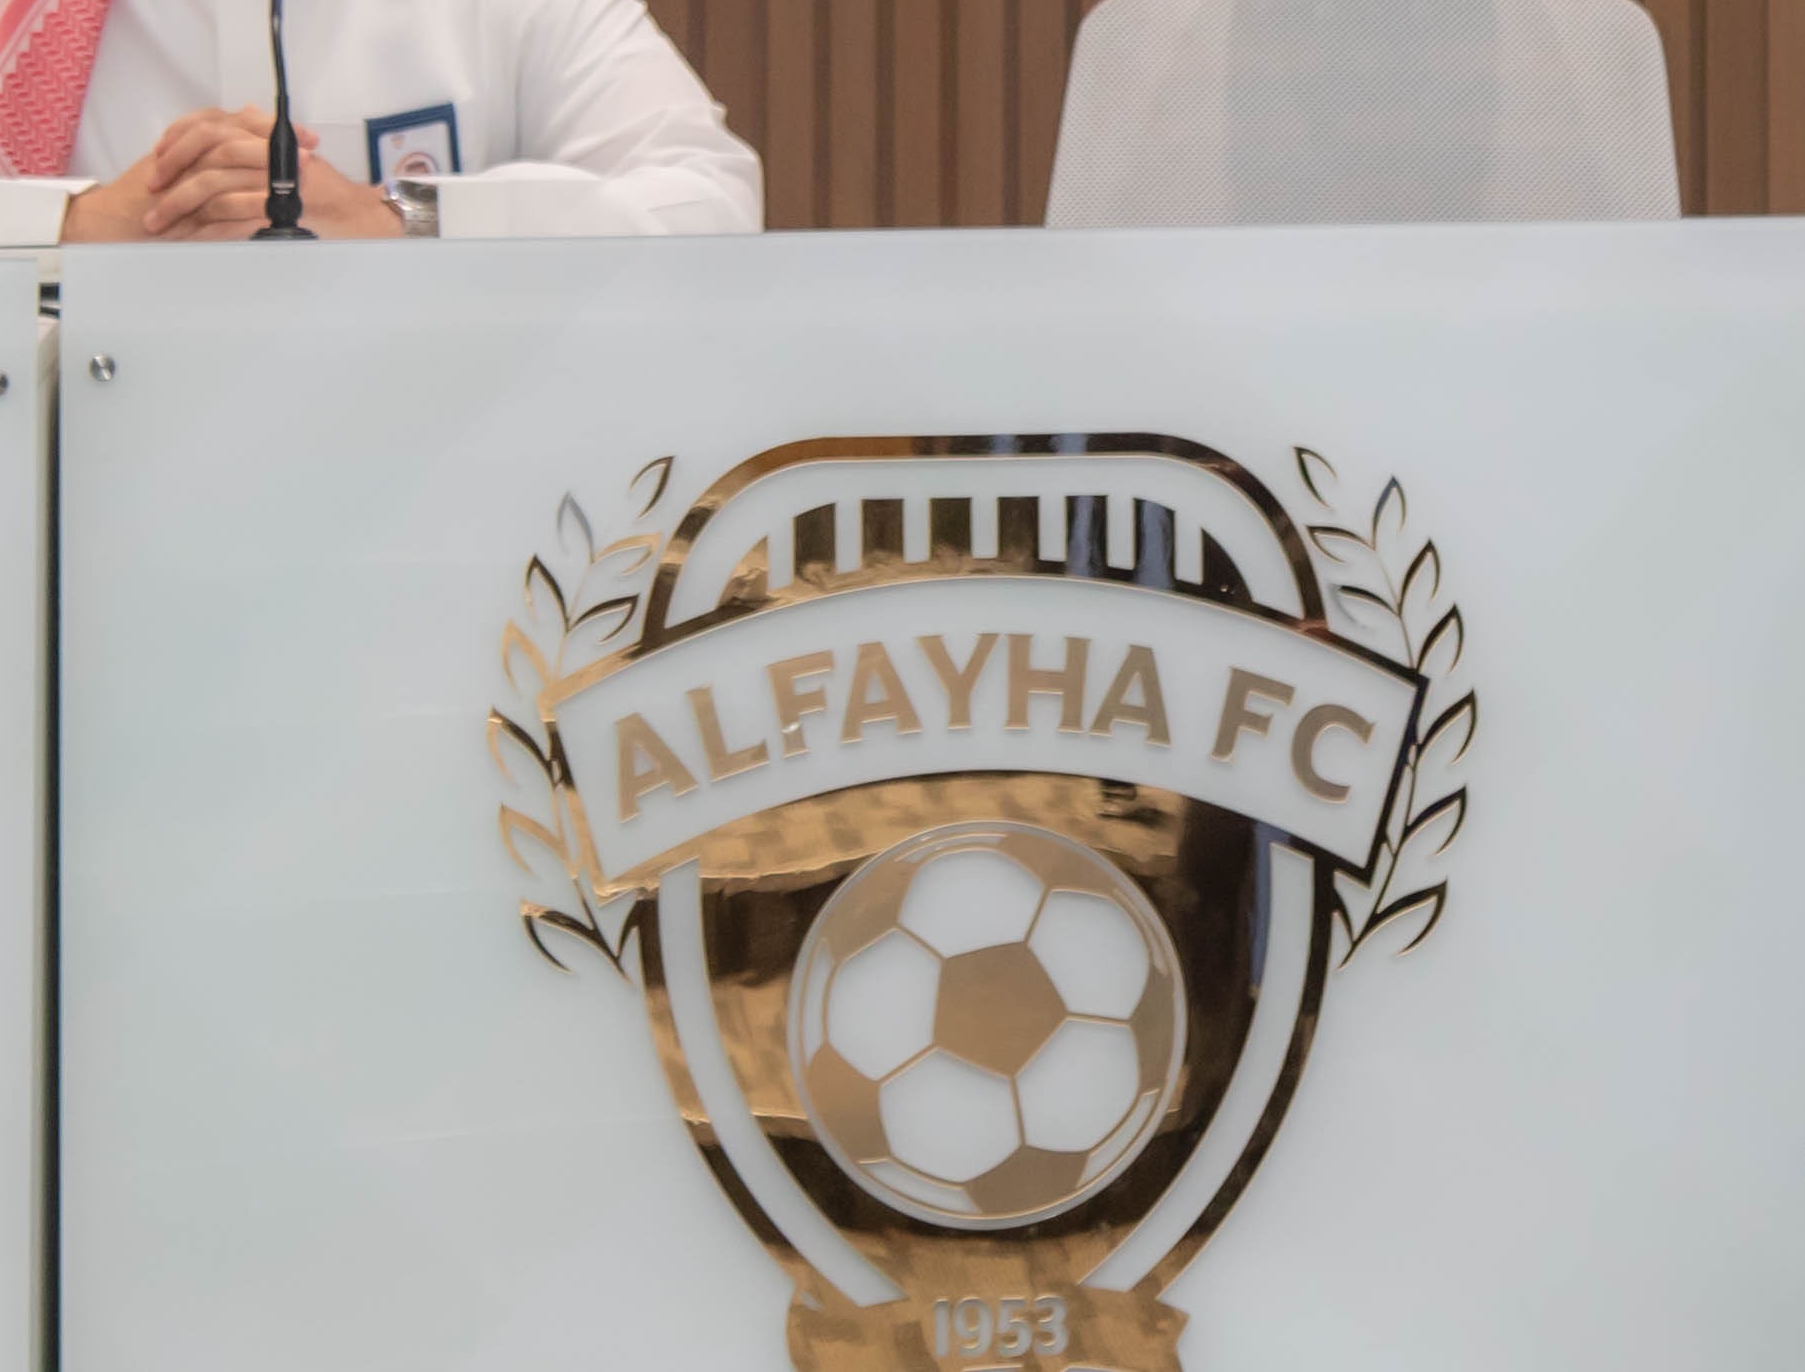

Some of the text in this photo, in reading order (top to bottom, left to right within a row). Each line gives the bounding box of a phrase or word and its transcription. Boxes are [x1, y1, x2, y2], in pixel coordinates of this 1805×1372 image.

[614, 631, 1377, 823] ALFAYHA FC
[933, 1293, 1070, 1359] 1953
